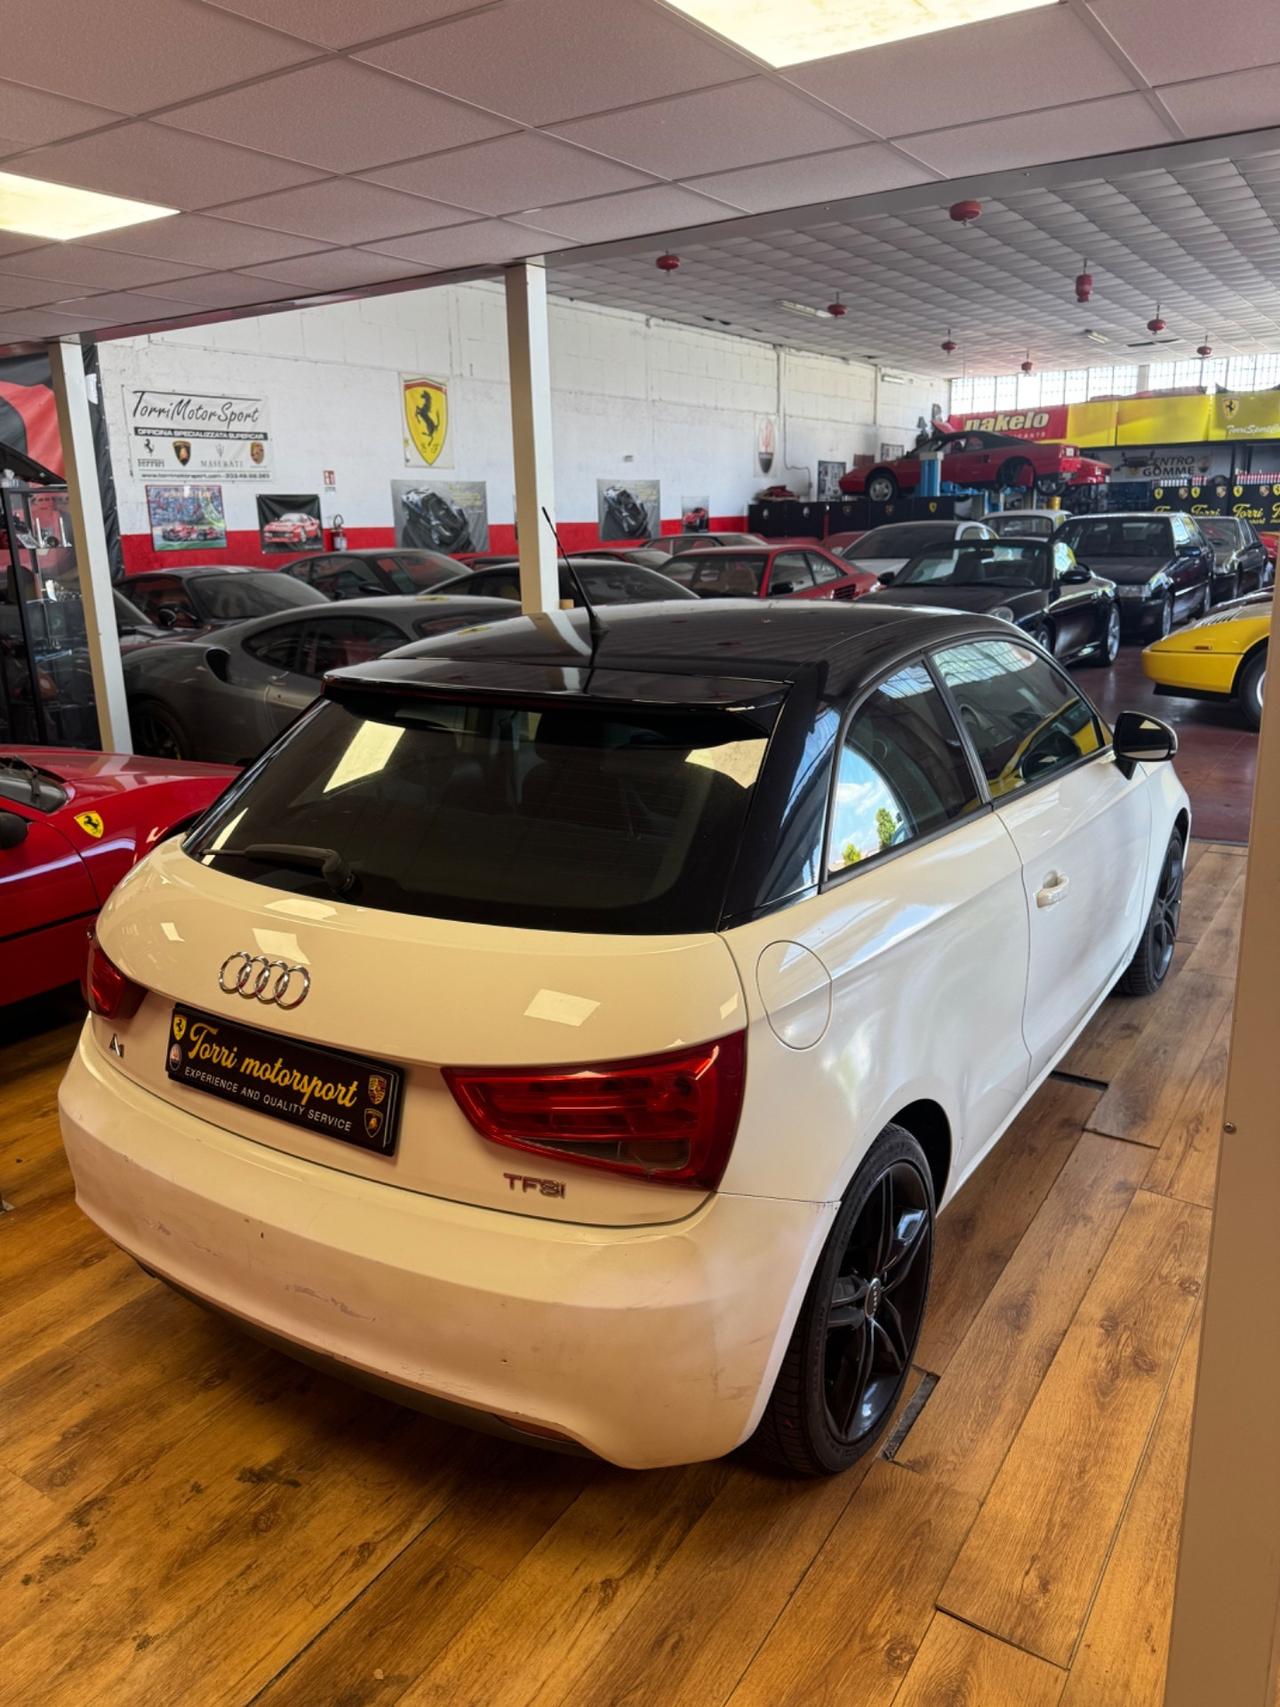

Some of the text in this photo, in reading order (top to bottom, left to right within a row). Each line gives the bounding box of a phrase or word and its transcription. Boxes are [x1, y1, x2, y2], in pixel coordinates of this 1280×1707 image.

[133, 390, 262, 430] TorriMotorSport
[137, 428, 173, 437] OFFICINA
[174, 430, 228, 439] SPECIALIZZATA
[1143, 466, 1195, 477] GOMME
[1232, 503, 1264, 519] Torri
[188, 1022, 359, 1108] Torri motorsport
[184, 1065, 353, 1132] EXPERIENCE AND QUALITY SERVICE
[503, 1172, 566, 1199] TFSI
